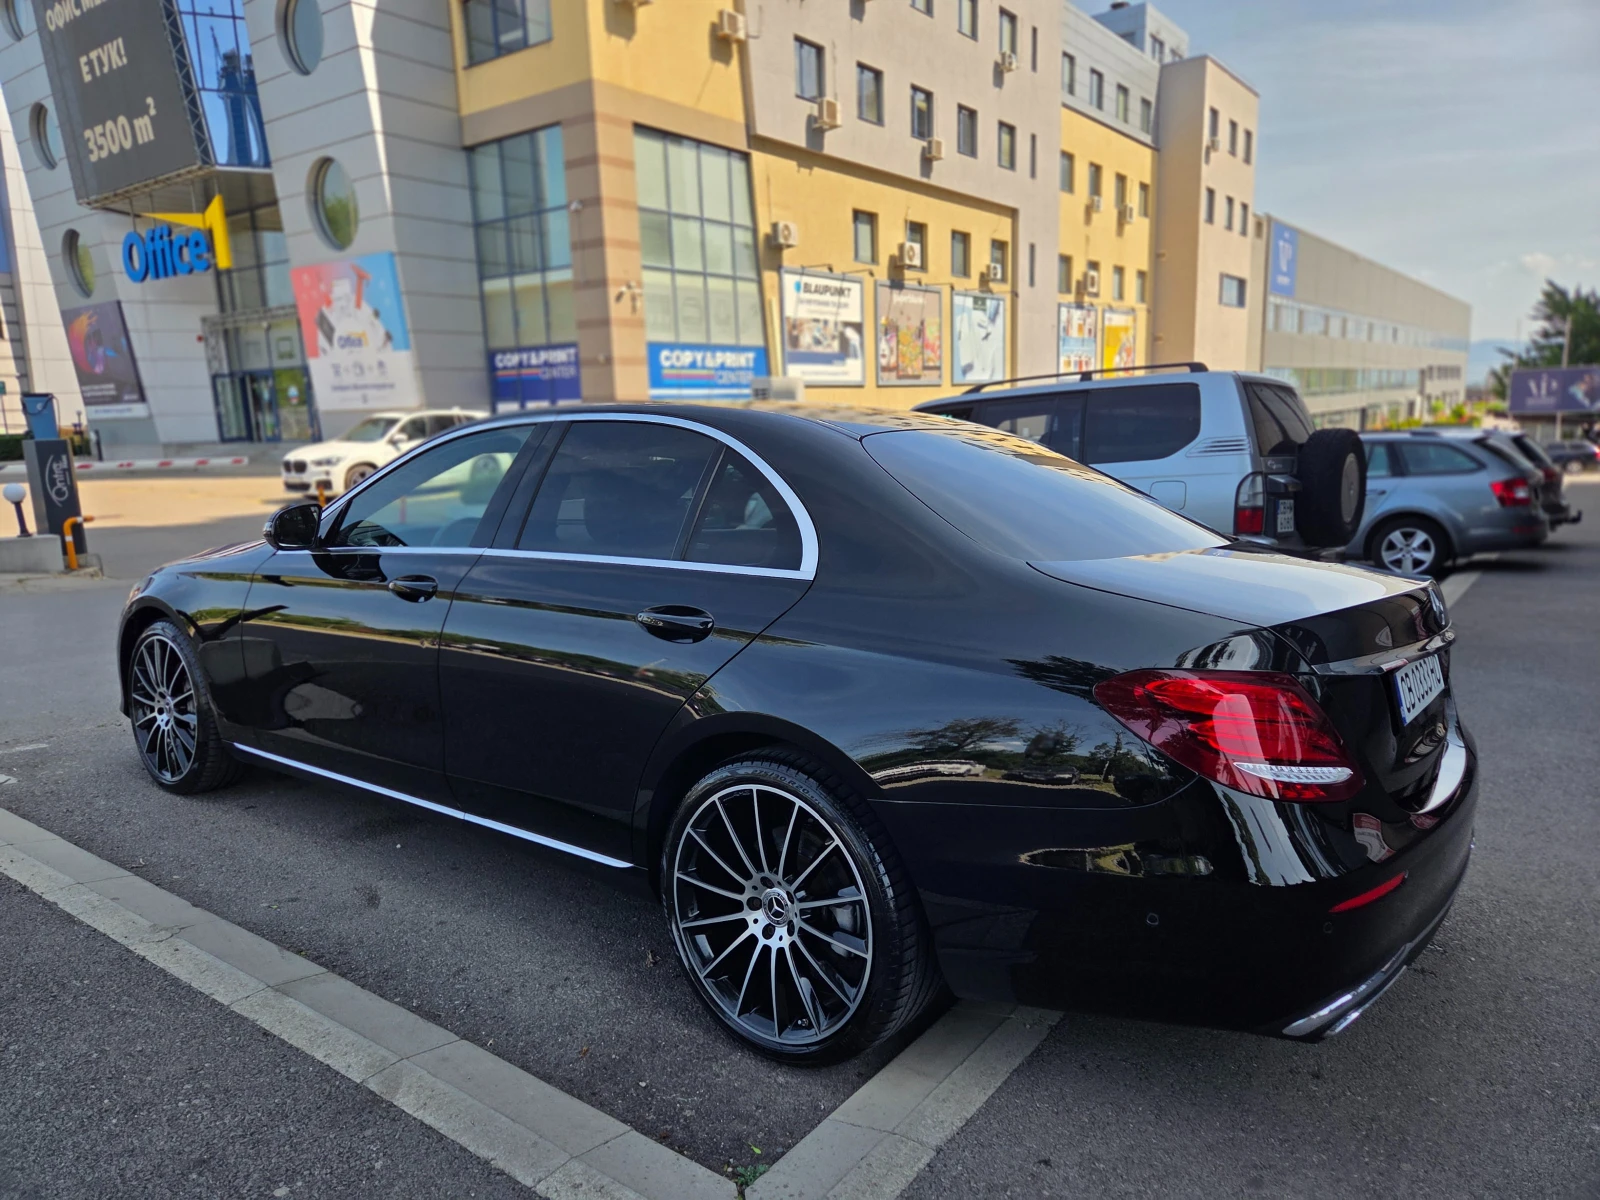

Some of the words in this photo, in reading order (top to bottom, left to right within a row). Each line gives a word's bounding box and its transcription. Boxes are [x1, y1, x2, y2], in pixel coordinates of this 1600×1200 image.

[89, 36, 128, 76] ТУК!
[84, 115, 132, 162] 3500
[122, 223, 210, 283] Office
[803, 282, 851, 298] BLAUPUNKT
